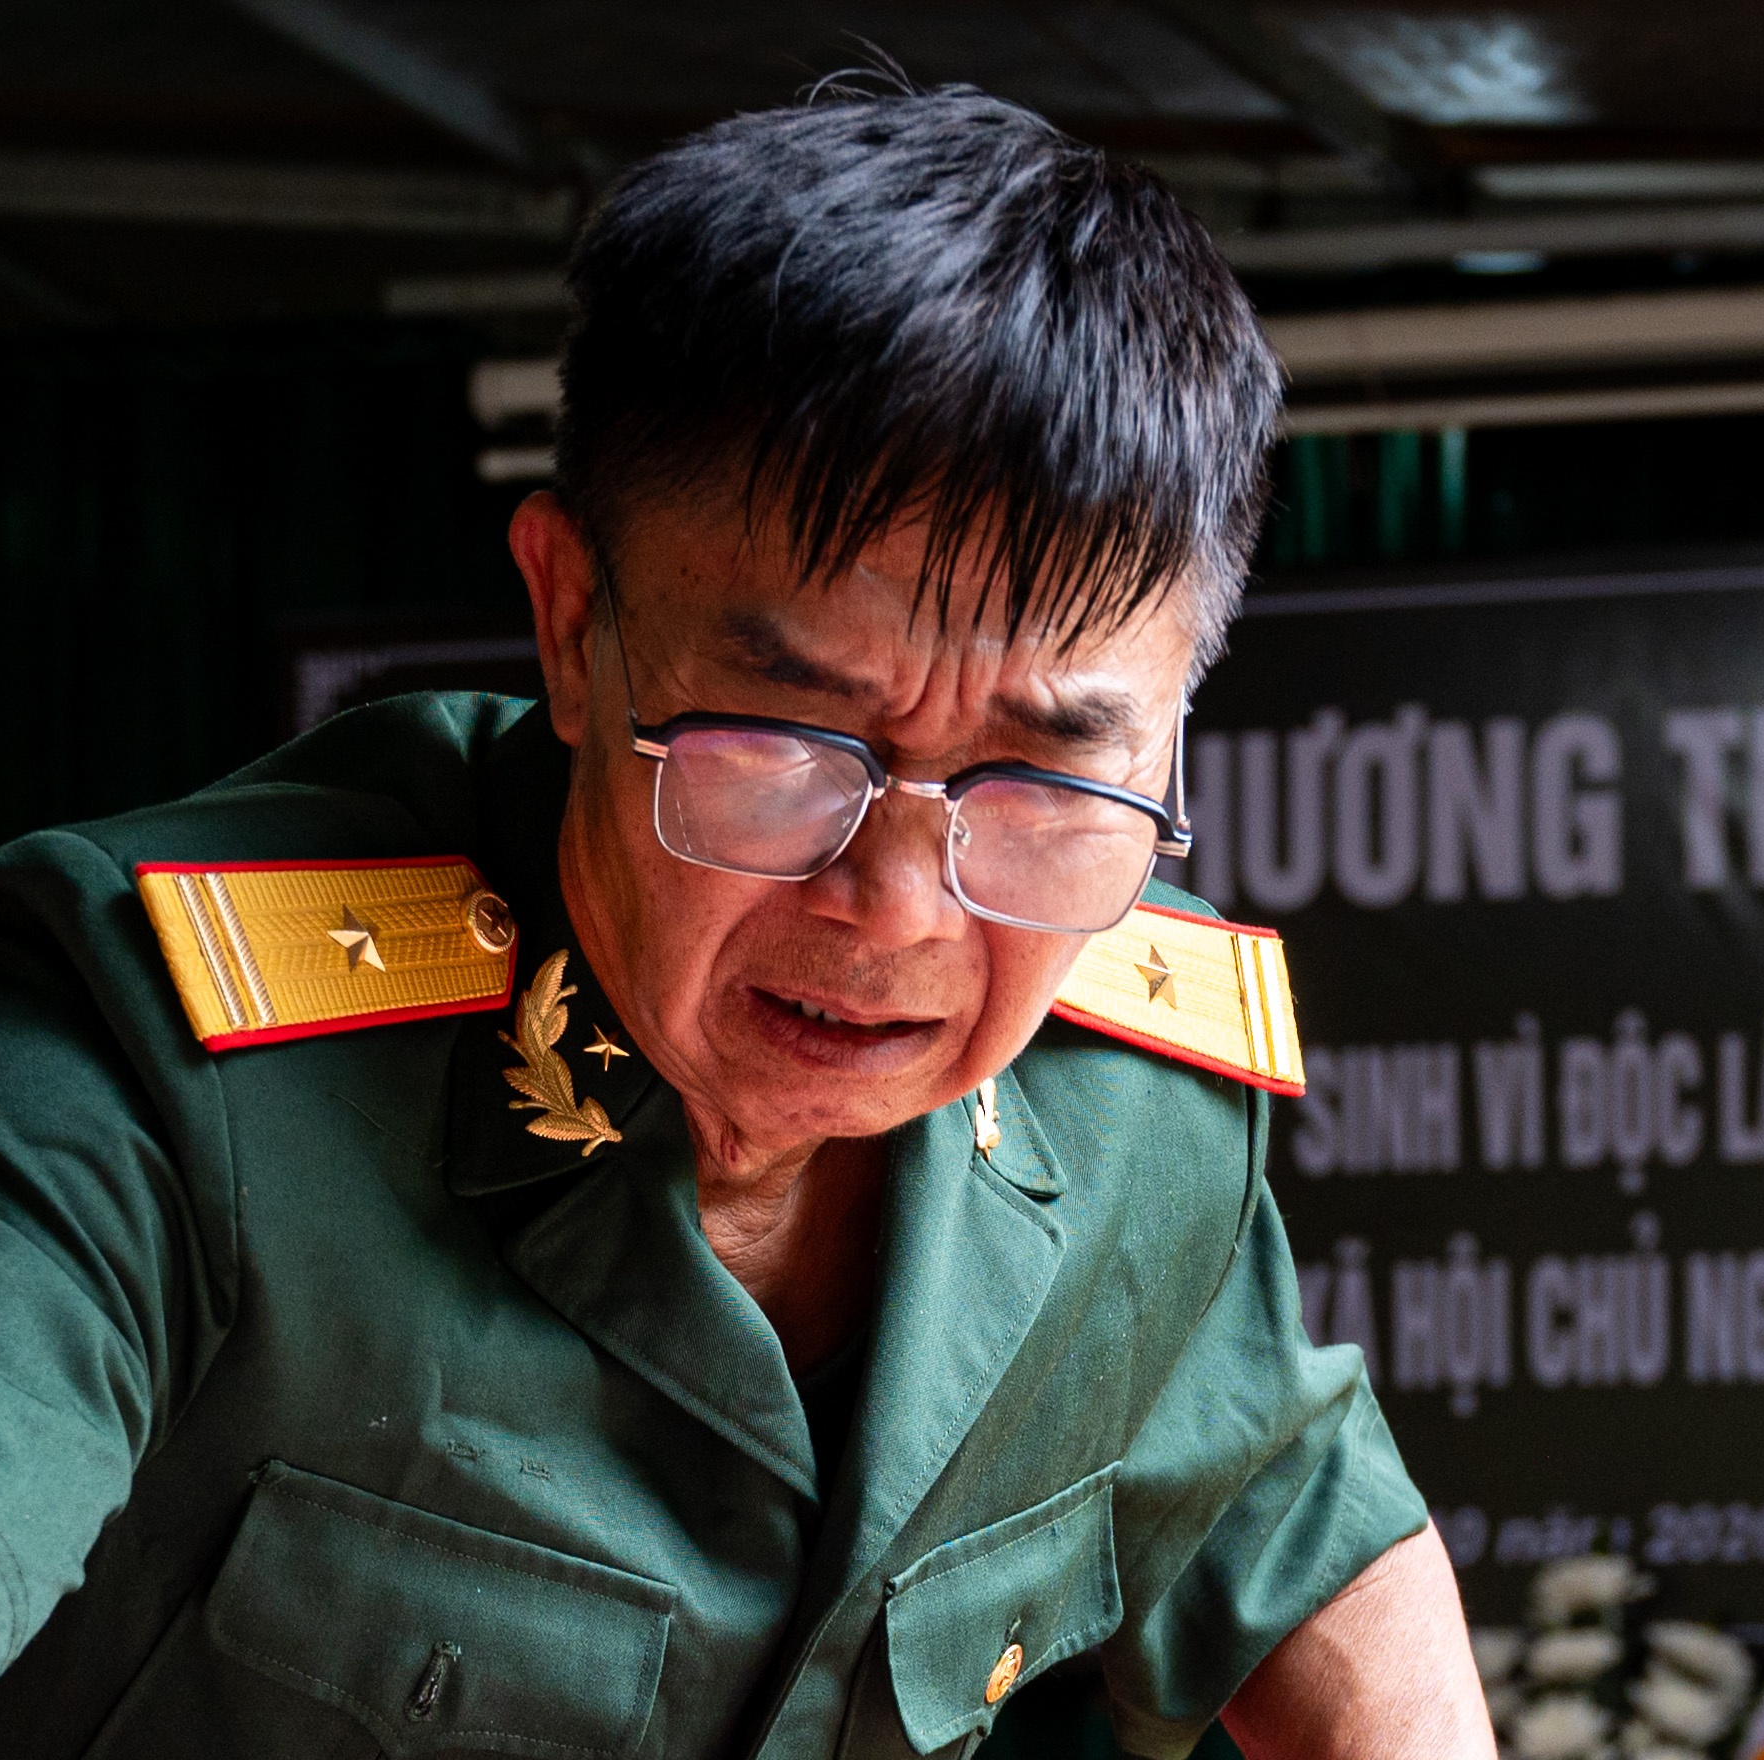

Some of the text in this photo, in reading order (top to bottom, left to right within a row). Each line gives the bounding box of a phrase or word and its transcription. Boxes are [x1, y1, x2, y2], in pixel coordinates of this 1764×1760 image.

[1294, 1046, 1461, 1177] SINH
[1471, 1009, 1545, 1171] VÌ
[1559, 1008, 1704, 1193] ĐỘC
[1392, 1232, 1513, 1416] HỘI
[1527, 1210, 1670, 1389] CHỦ
